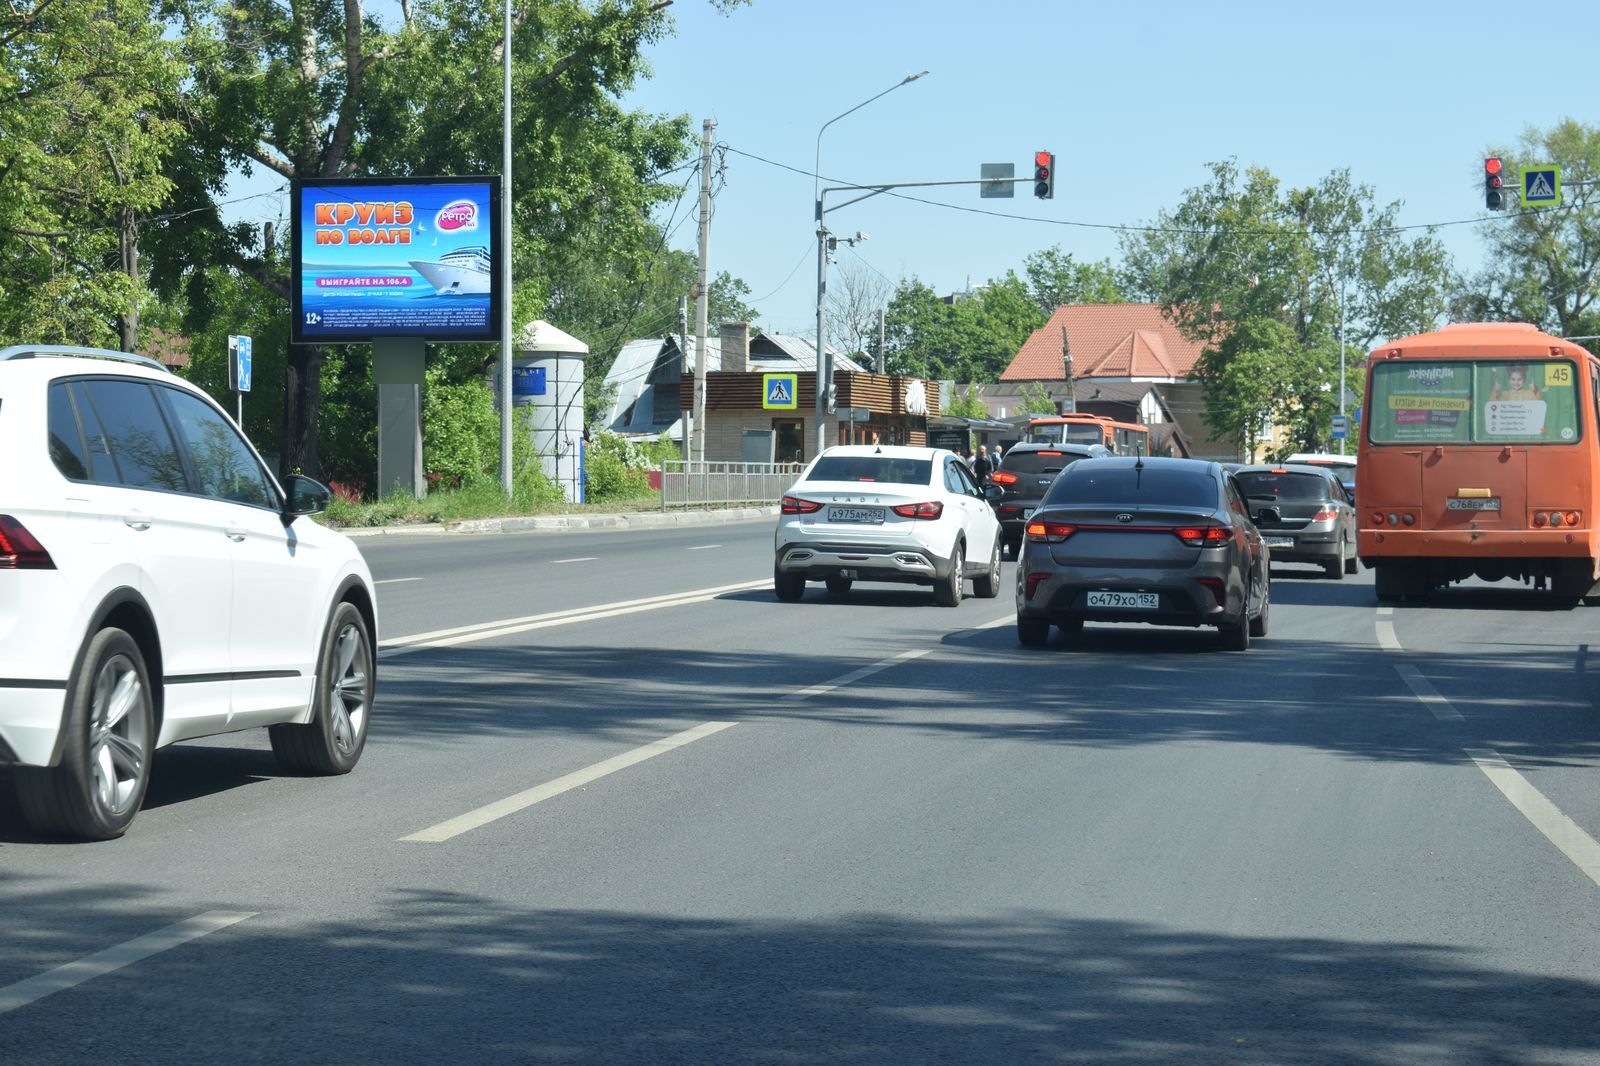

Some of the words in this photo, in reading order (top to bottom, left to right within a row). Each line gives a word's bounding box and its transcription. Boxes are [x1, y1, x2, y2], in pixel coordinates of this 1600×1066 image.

[315, 202, 414, 226] КРУИЗ
[441, 211, 473, 223] Ретро
[316, 229, 344, 245] ПО
[347, 228, 412, 245] ВОЛГЕ
[320, 278, 371, 286] ВЫИГРАЙТЕ
[386, 278, 408, 286] 106.4
[306, 312, 321, 324] 12+
